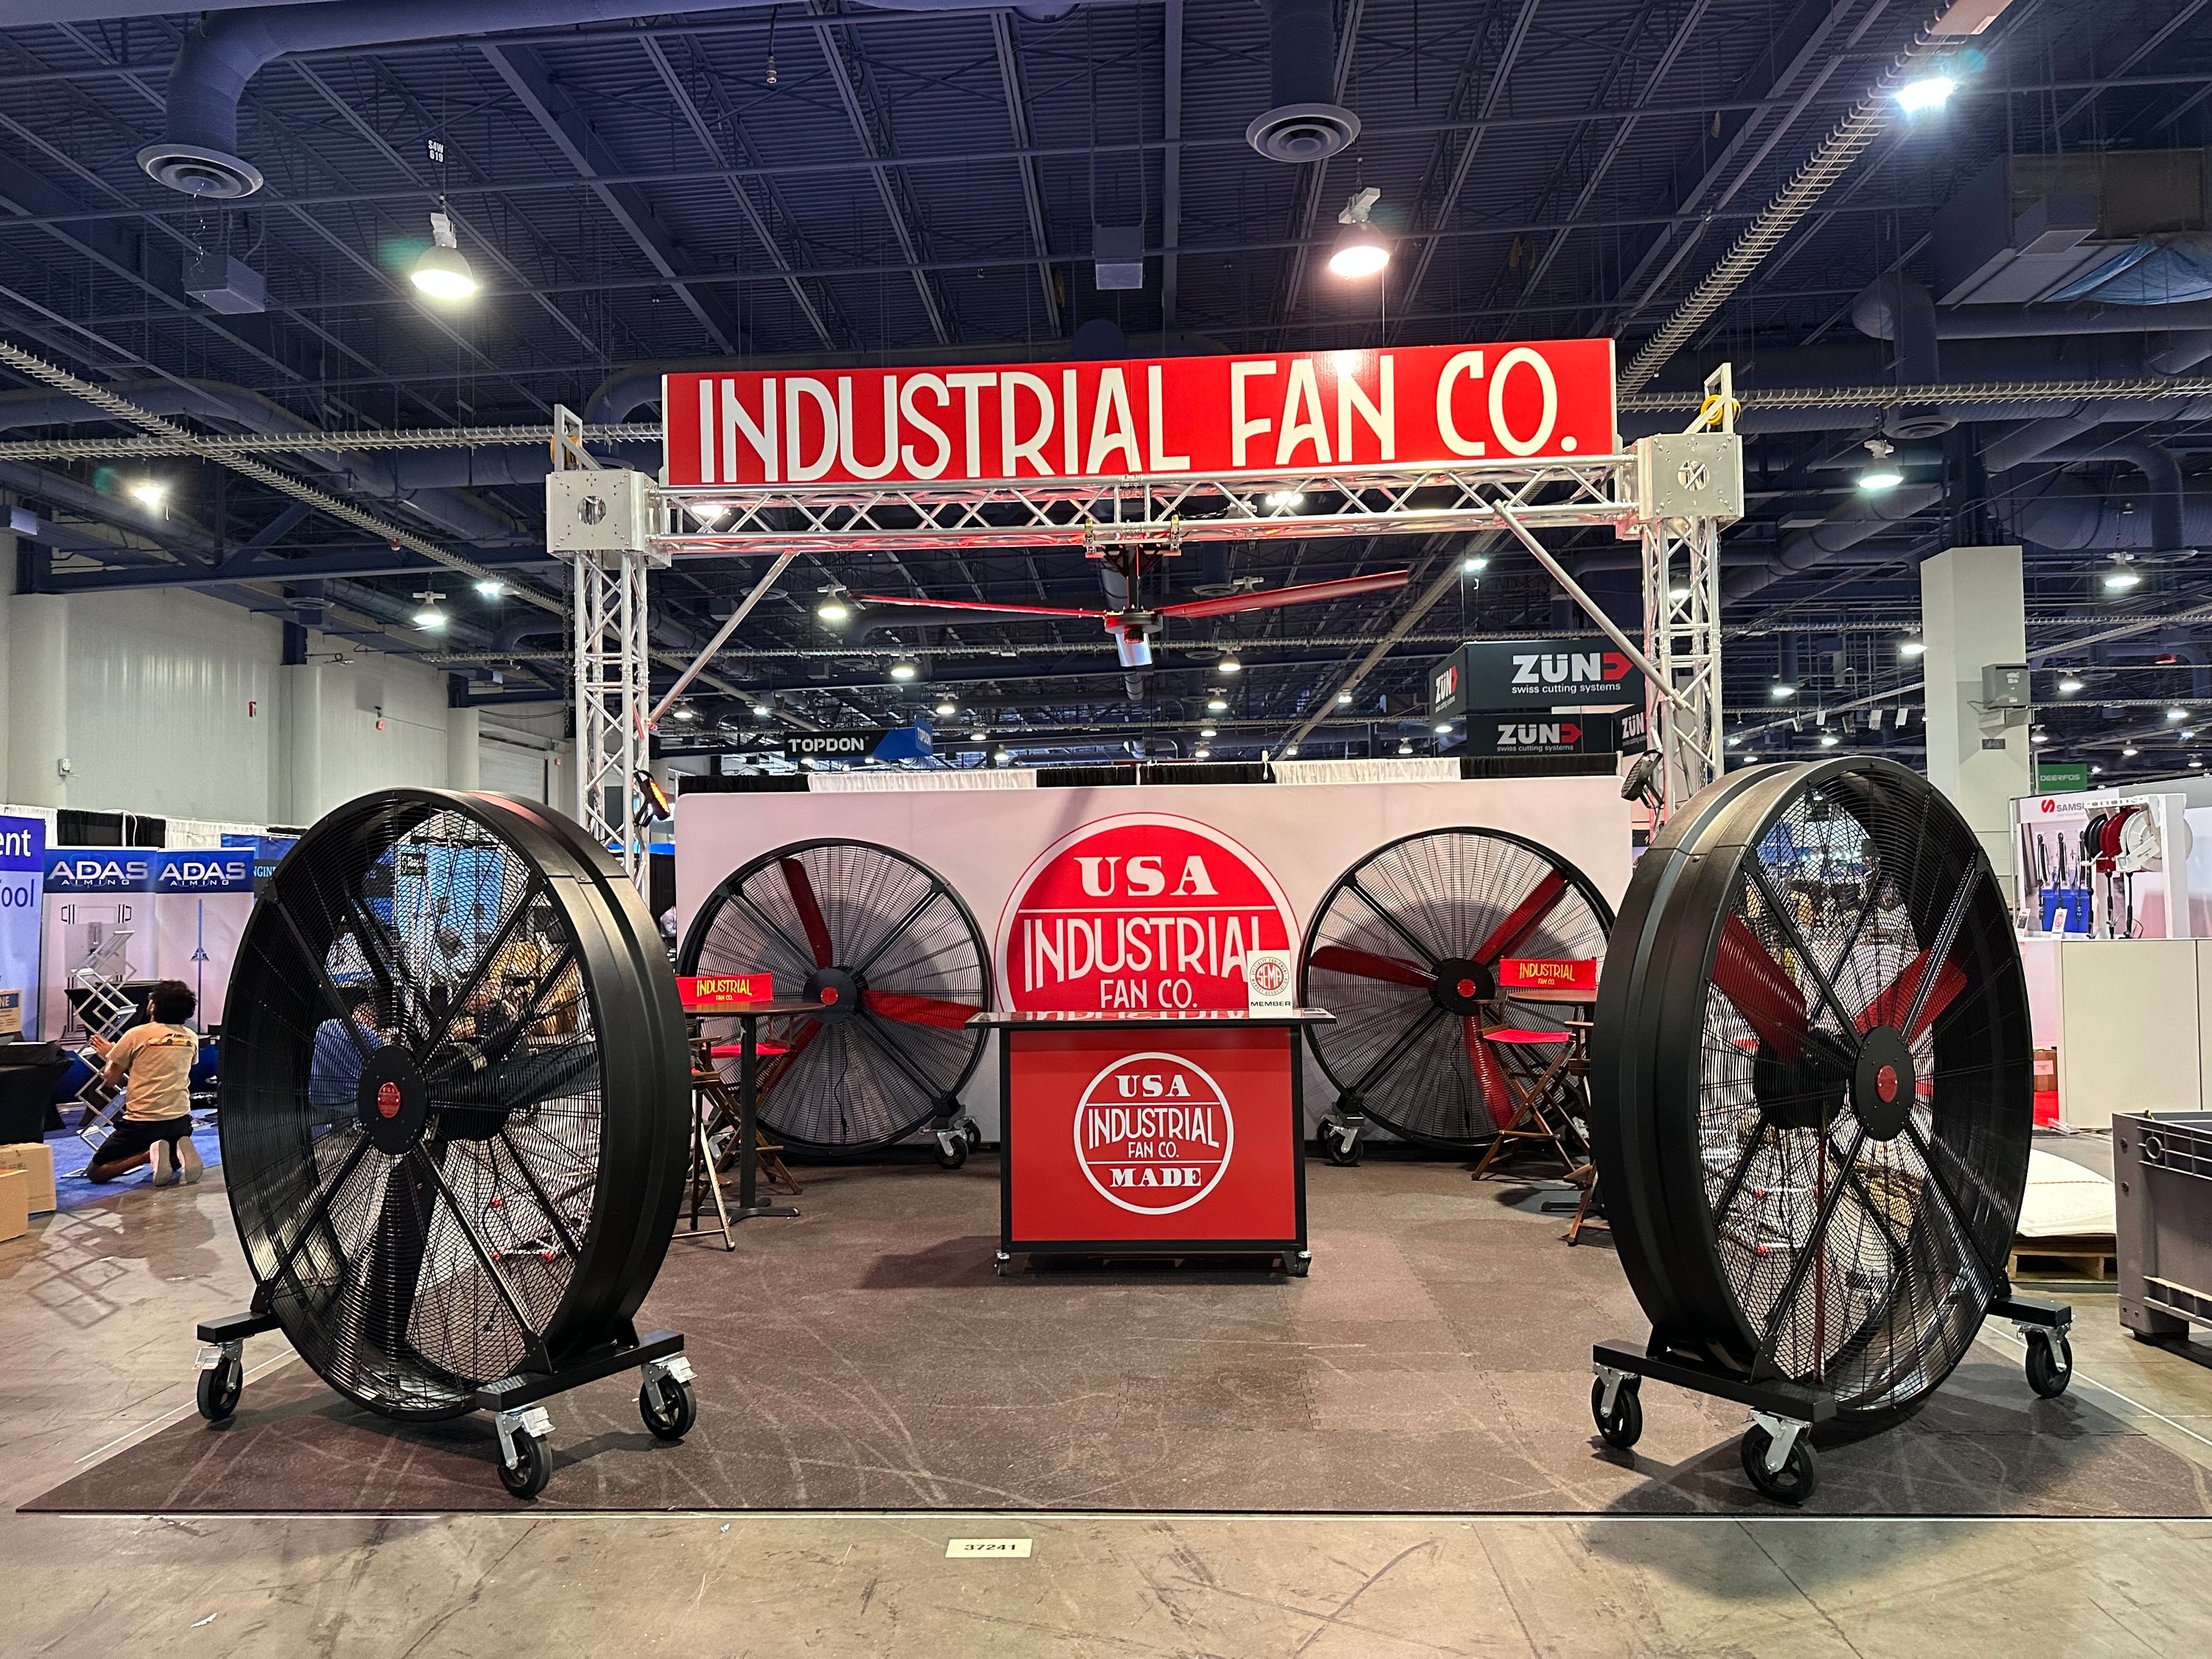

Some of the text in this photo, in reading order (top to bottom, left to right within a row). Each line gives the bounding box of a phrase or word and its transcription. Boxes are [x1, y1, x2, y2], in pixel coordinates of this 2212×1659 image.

[429, 150, 444, 162] 619
[699, 347, 1578, 483] INDUSTRIAL FAN CO.
[1512, 683, 1621, 695] swiss cutting systems
[787, 737, 864, 752] TOPDON
[1518, 745, 1543, 753] cutting
[1544, 744, 1574, 753] systems
[2056, 803, 2084, 812] SAMS
[47, 860, 148, 880] ADAS
[159, 861, 246, 881] ADAS
[1074, 855, 1219, 897] USA
[1256, 963, 1282, 990] SEMA
[1519, 962, 1576, 982] INDUSTRIAL
[696, 979, 752, 998] INDUSTRIAL
[1100, 978, 1198, 1009] FAN CO.
[1115, 1074, 1191, 1098] USA
[1088, 1107, 1220, 1150] INDUSTRIAL
[1128, 1141, 1180, 1158] FAN CO.
[1109, 1167, 1202, 1187] MADE
